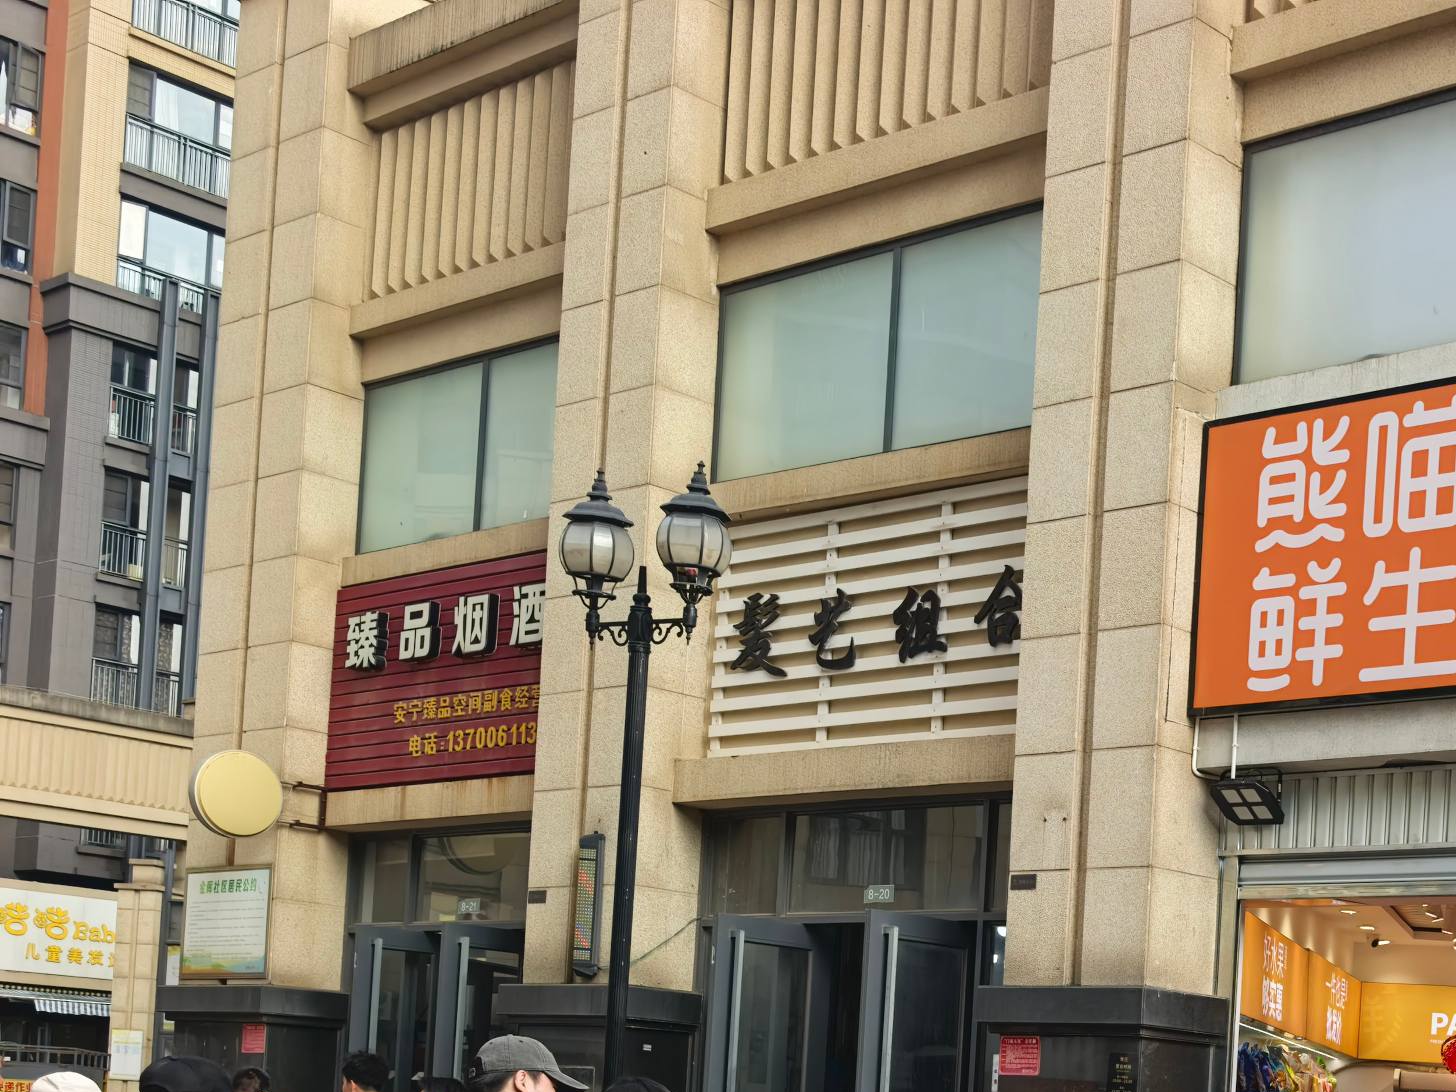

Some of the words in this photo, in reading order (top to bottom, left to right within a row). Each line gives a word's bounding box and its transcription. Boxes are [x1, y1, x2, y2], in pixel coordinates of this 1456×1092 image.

[345, 583, 546, 670] 臻品烟酒
[868, 888, 890, 900] 8-20
[461, 901, 477, 912] 8-21
